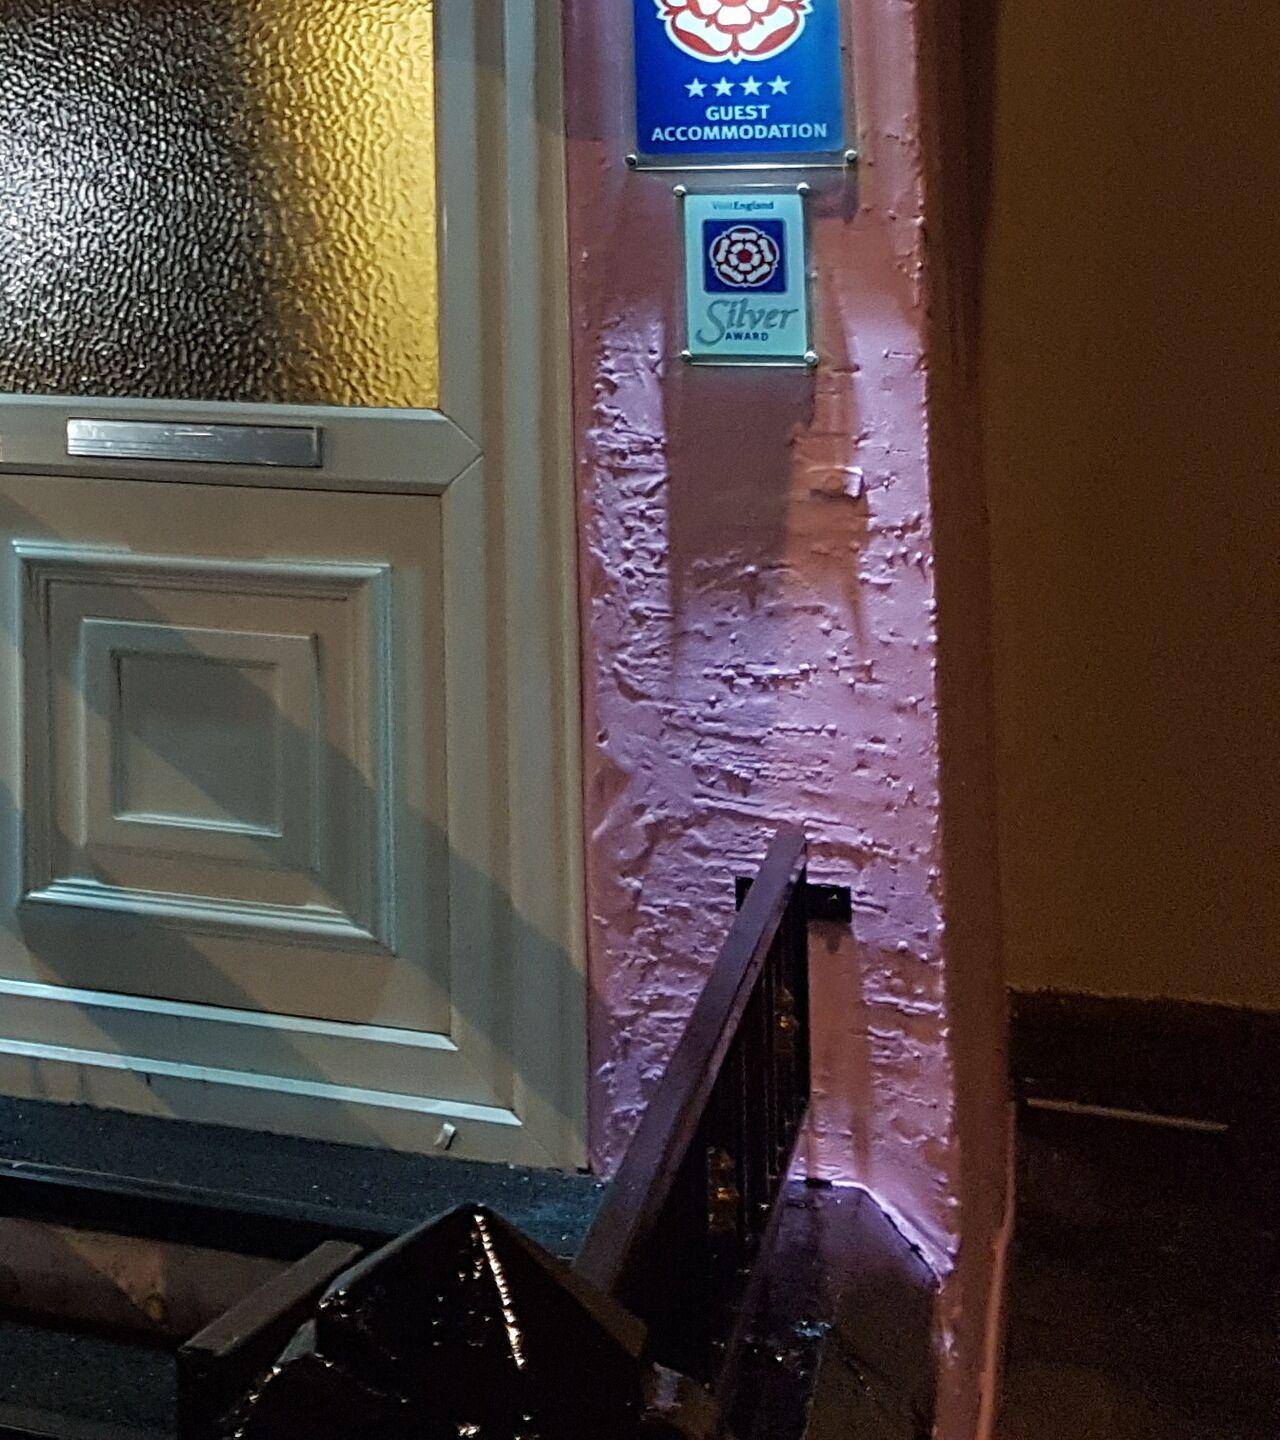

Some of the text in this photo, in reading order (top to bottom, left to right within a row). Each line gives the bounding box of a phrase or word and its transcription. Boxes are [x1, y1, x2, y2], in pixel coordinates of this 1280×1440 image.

[705, 104, 771, 121] GUEST
[651, 123, 828, 142] ACCOMMODATION
[695, 297, 800, 347] Silver
[725, 332, 769, 342] AWARD
